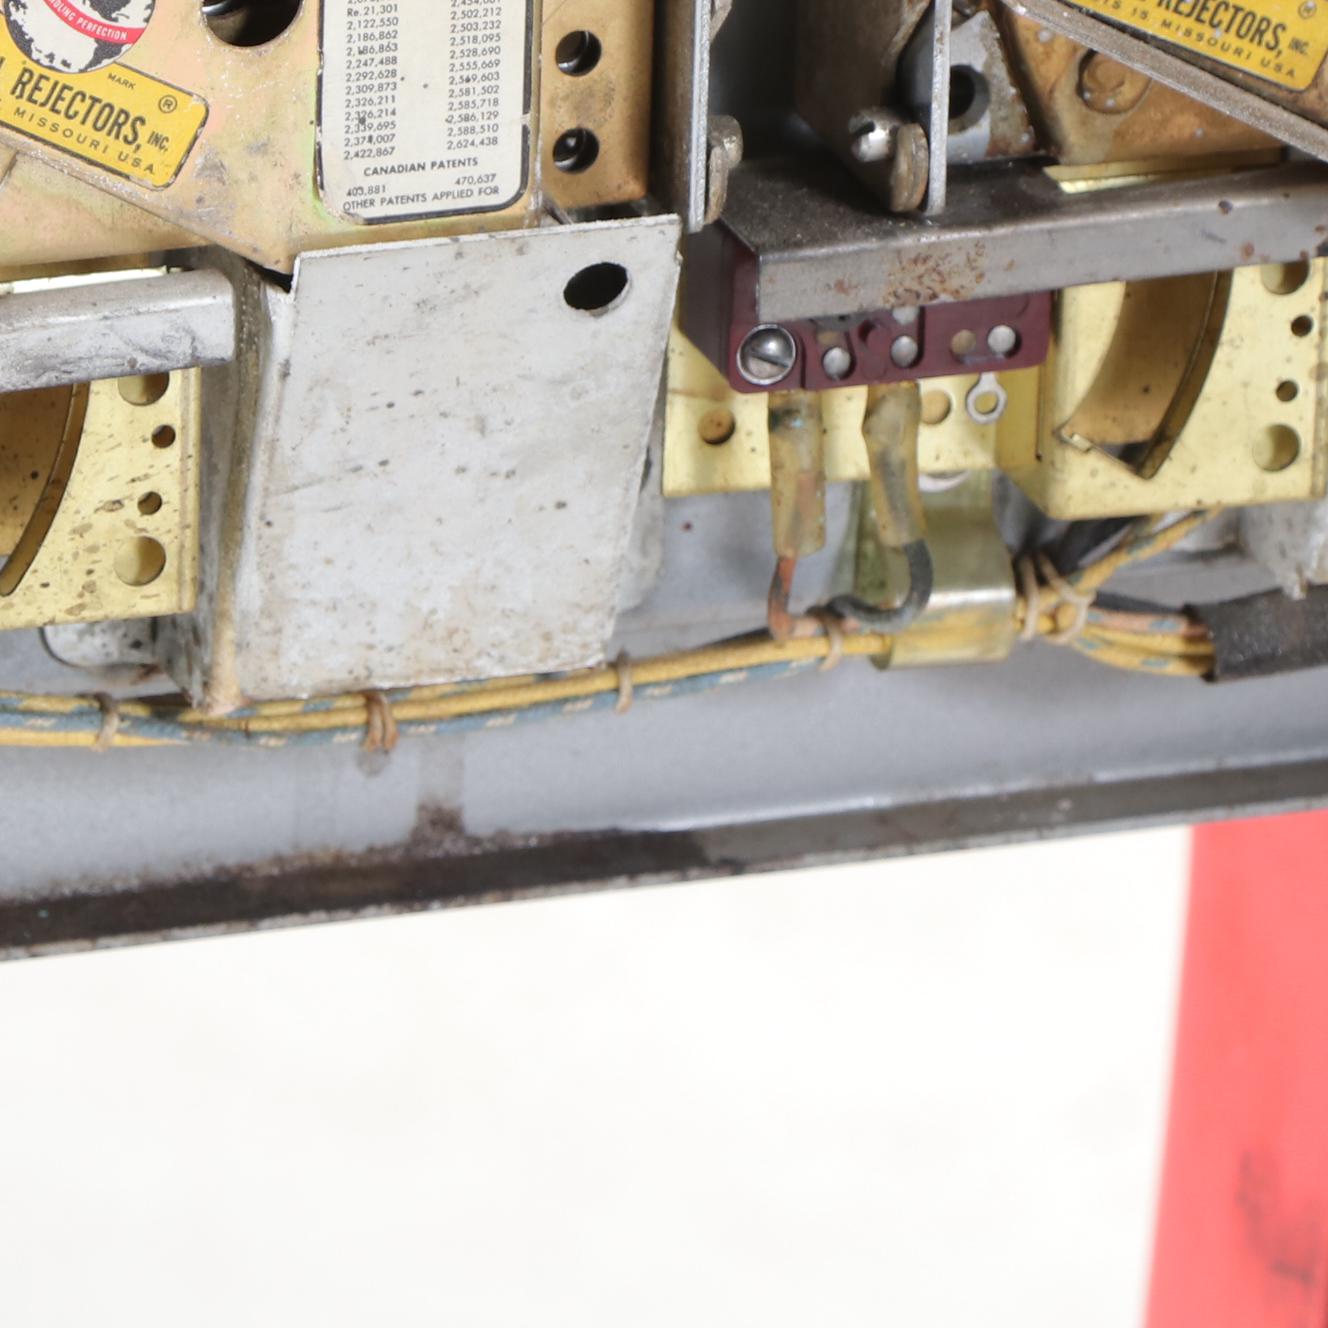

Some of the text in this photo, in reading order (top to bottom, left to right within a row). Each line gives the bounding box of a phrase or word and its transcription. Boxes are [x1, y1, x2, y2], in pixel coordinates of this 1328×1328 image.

[450, 7, 502, 20] 2,502,212
[77, 18, 128, 40] PERFECTION
[346, 17, 399, 30] 2,122,550
[450, 20, 501, 33] 2,503,232
[346, 30, 398, 44] 2,186,862
[450, 33, 501, 46] 2,518,095
[1161, 20, 1252, 60] MISSOURI
[449, 46, 501, 59] 2,528,690
[345, 56, 397, 69] 2,247,488
[449, 59, 501, 72] 2,555,669
[107, 73, 136, 90] MARK
[345, 69, 397, 83] 2,292,628
[345, 82, 397, 95] 2,309,873
[448, 85, 500, 98] 2,581,502
[345, 95, 395, 108] 2,326,211
[448, 99, 499, 111] 2,585,718
[10, 66, 146, 154] REJECTORS,
[448, 111, 499, 124] 2,586,129
[14, 107, 109, 154] MISSOURI
[344, 121, 396, 134] 2,339,695
[447, 125, 499, 137] 2,588,510
[447, 136, 498, 150] 2,624,438
[344, 147, 395, 160] 2,422,867
[364, 157, 478, 177] CANADIAN PATENTS
[455, 174, 497, 186] 470,637
[346, 184, 386, 197] 403,881
[343, 186, 500, 211] OTHER PATENTS APPLIED FOR
